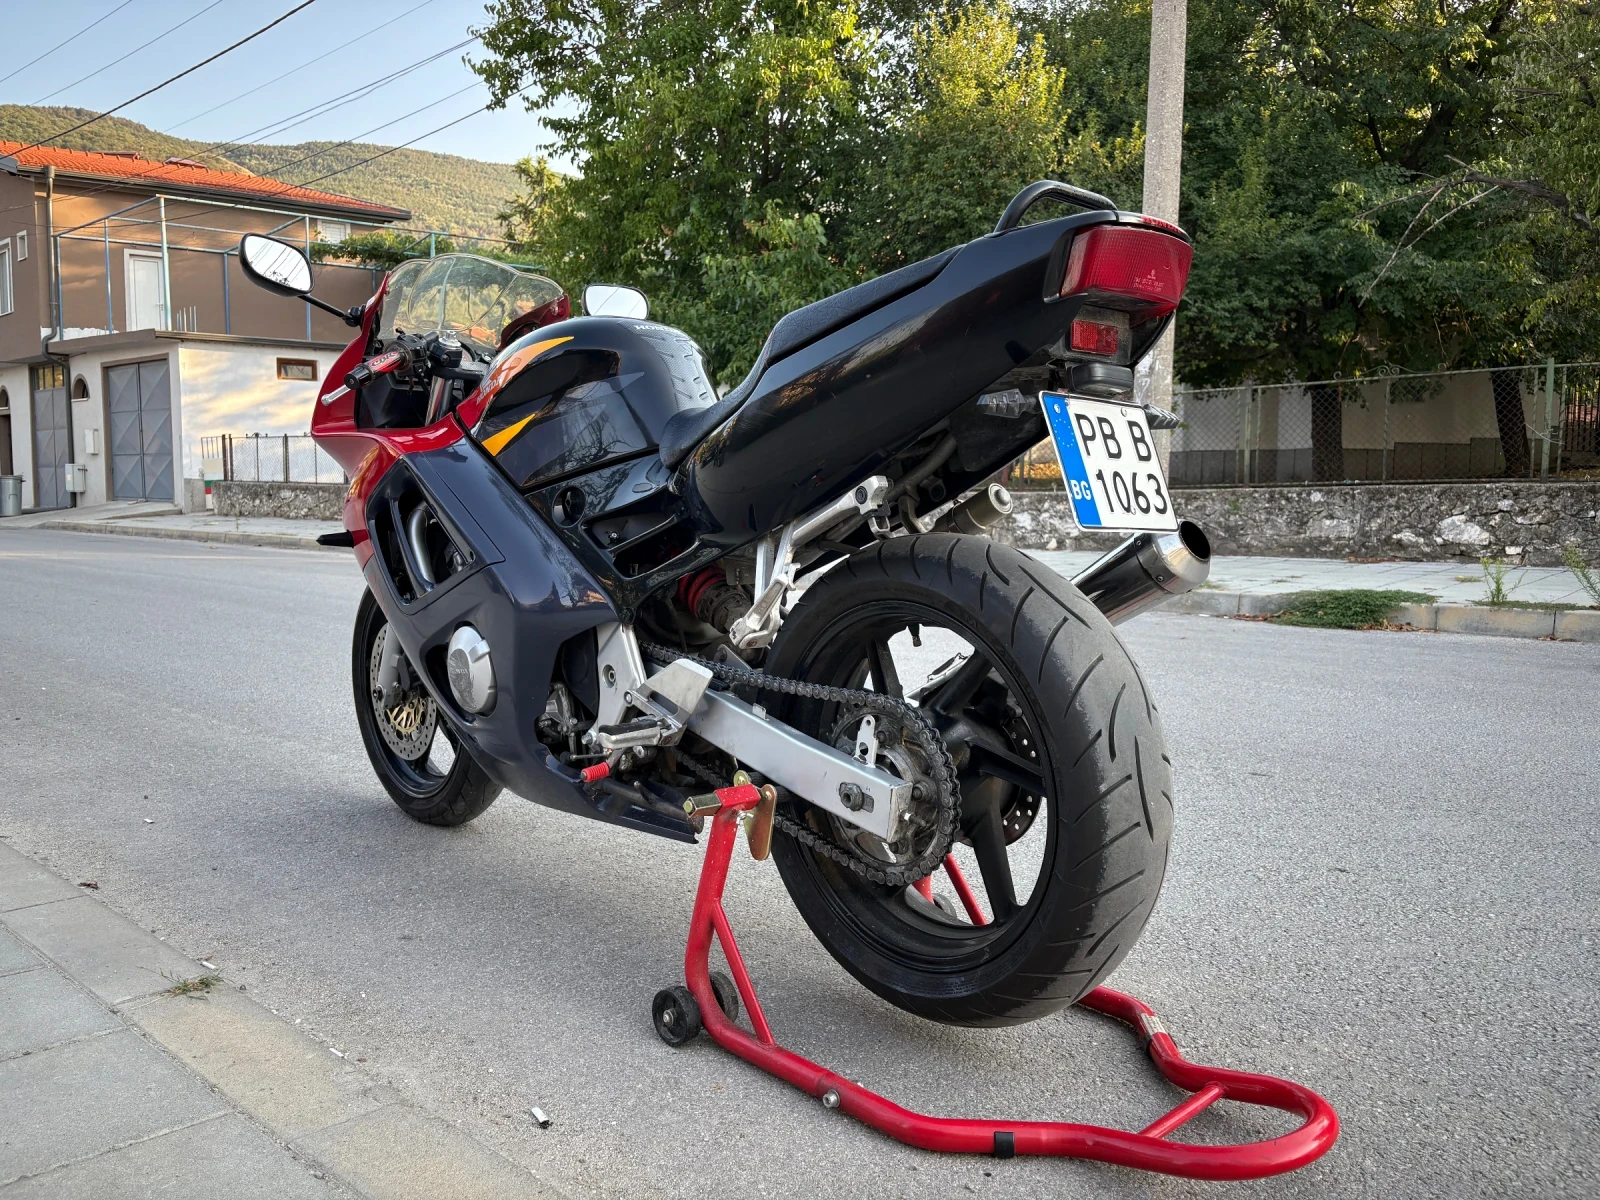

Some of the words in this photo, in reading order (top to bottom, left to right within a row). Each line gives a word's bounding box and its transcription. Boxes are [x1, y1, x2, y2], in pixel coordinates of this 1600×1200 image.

[1074, 413, 1122, 459] PB
[1127, 420, 1152, 461] B
[1070, 480, 1092, 500] BG
[1096, 469, 1168, 514] 1063
